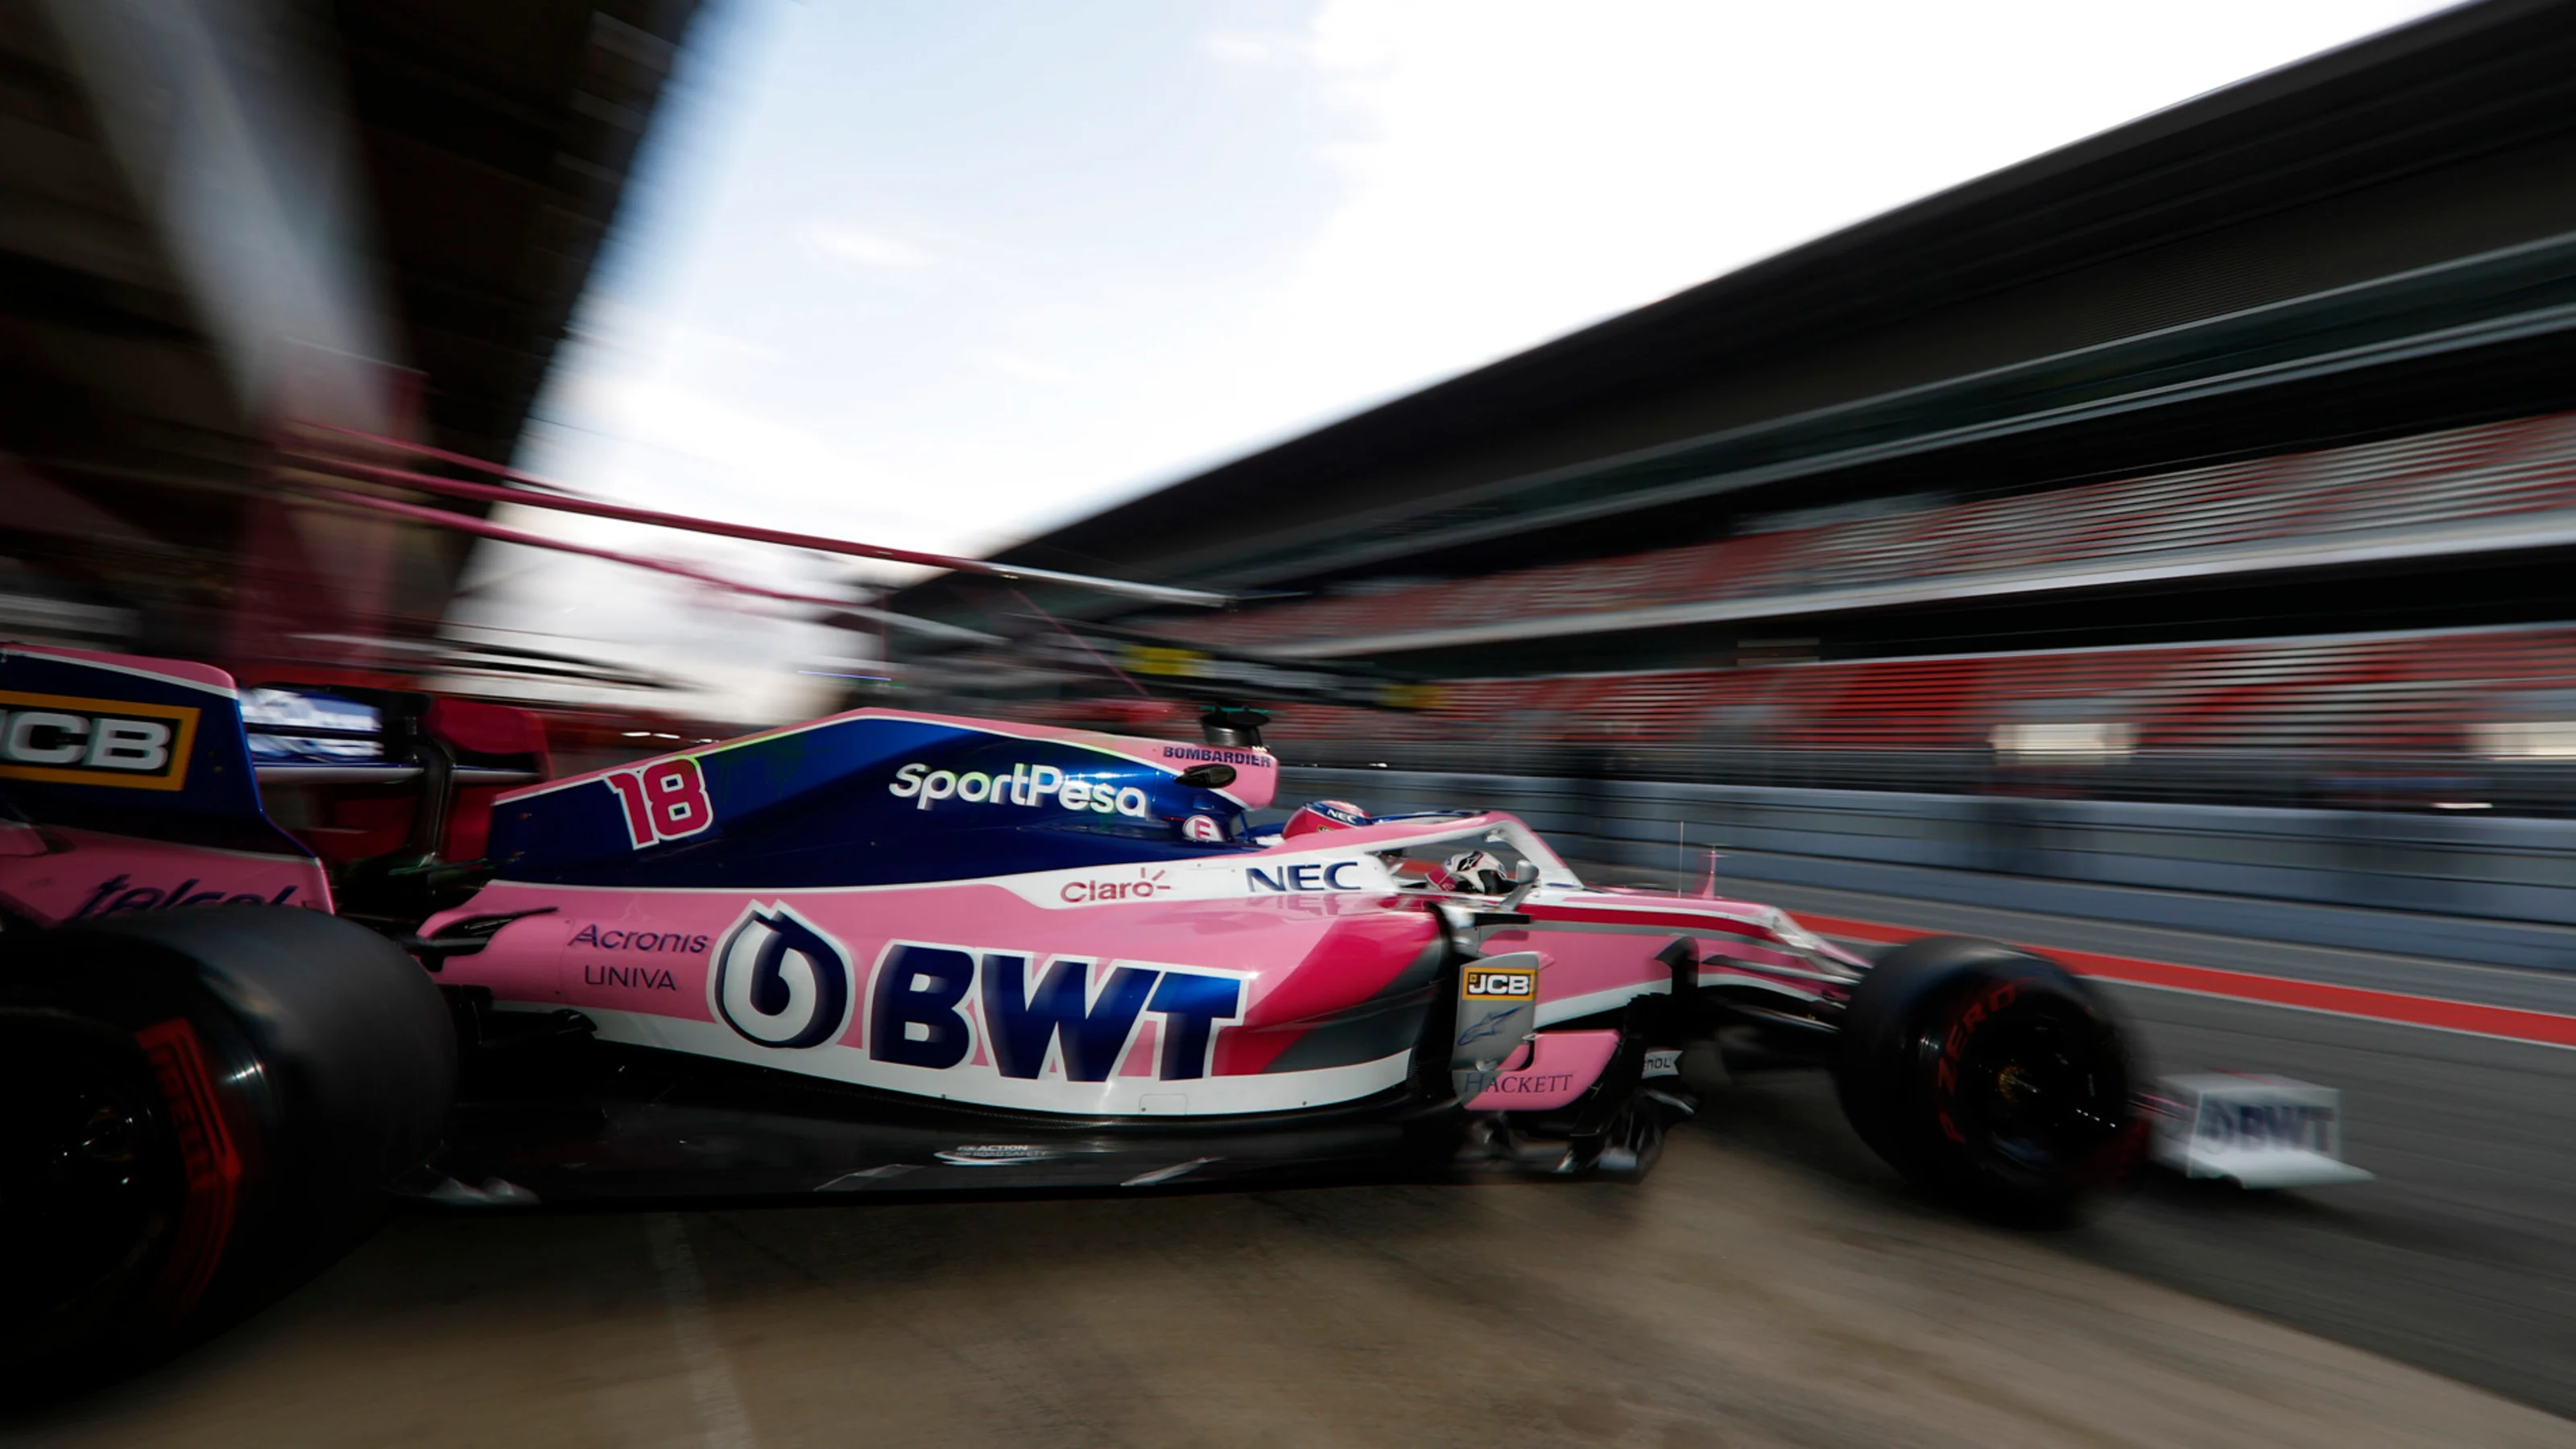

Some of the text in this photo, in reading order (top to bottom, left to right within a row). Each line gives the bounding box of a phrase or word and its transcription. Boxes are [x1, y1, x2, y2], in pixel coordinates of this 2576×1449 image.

[0, 712, 172, 770] CB
[1162, 746, 1271, 768] BOMBARDIER
[600, 754, 714, 851] 18
[889, 762, 1150, 819] SportPesa
[1326, 808, 1358, 824] NEC
[1060, 879, 1155, 903] Claro
[1245, 861, 1362, 893] NEC
[567, 923, 709, 953] Acronis
[585, 964, 677, 991] UNIVA
[1468, 973, 1530, 995] JCB
[869, 943, 1243, 1083] BWT
[1937, 981, 2017, 1097] ZERO
